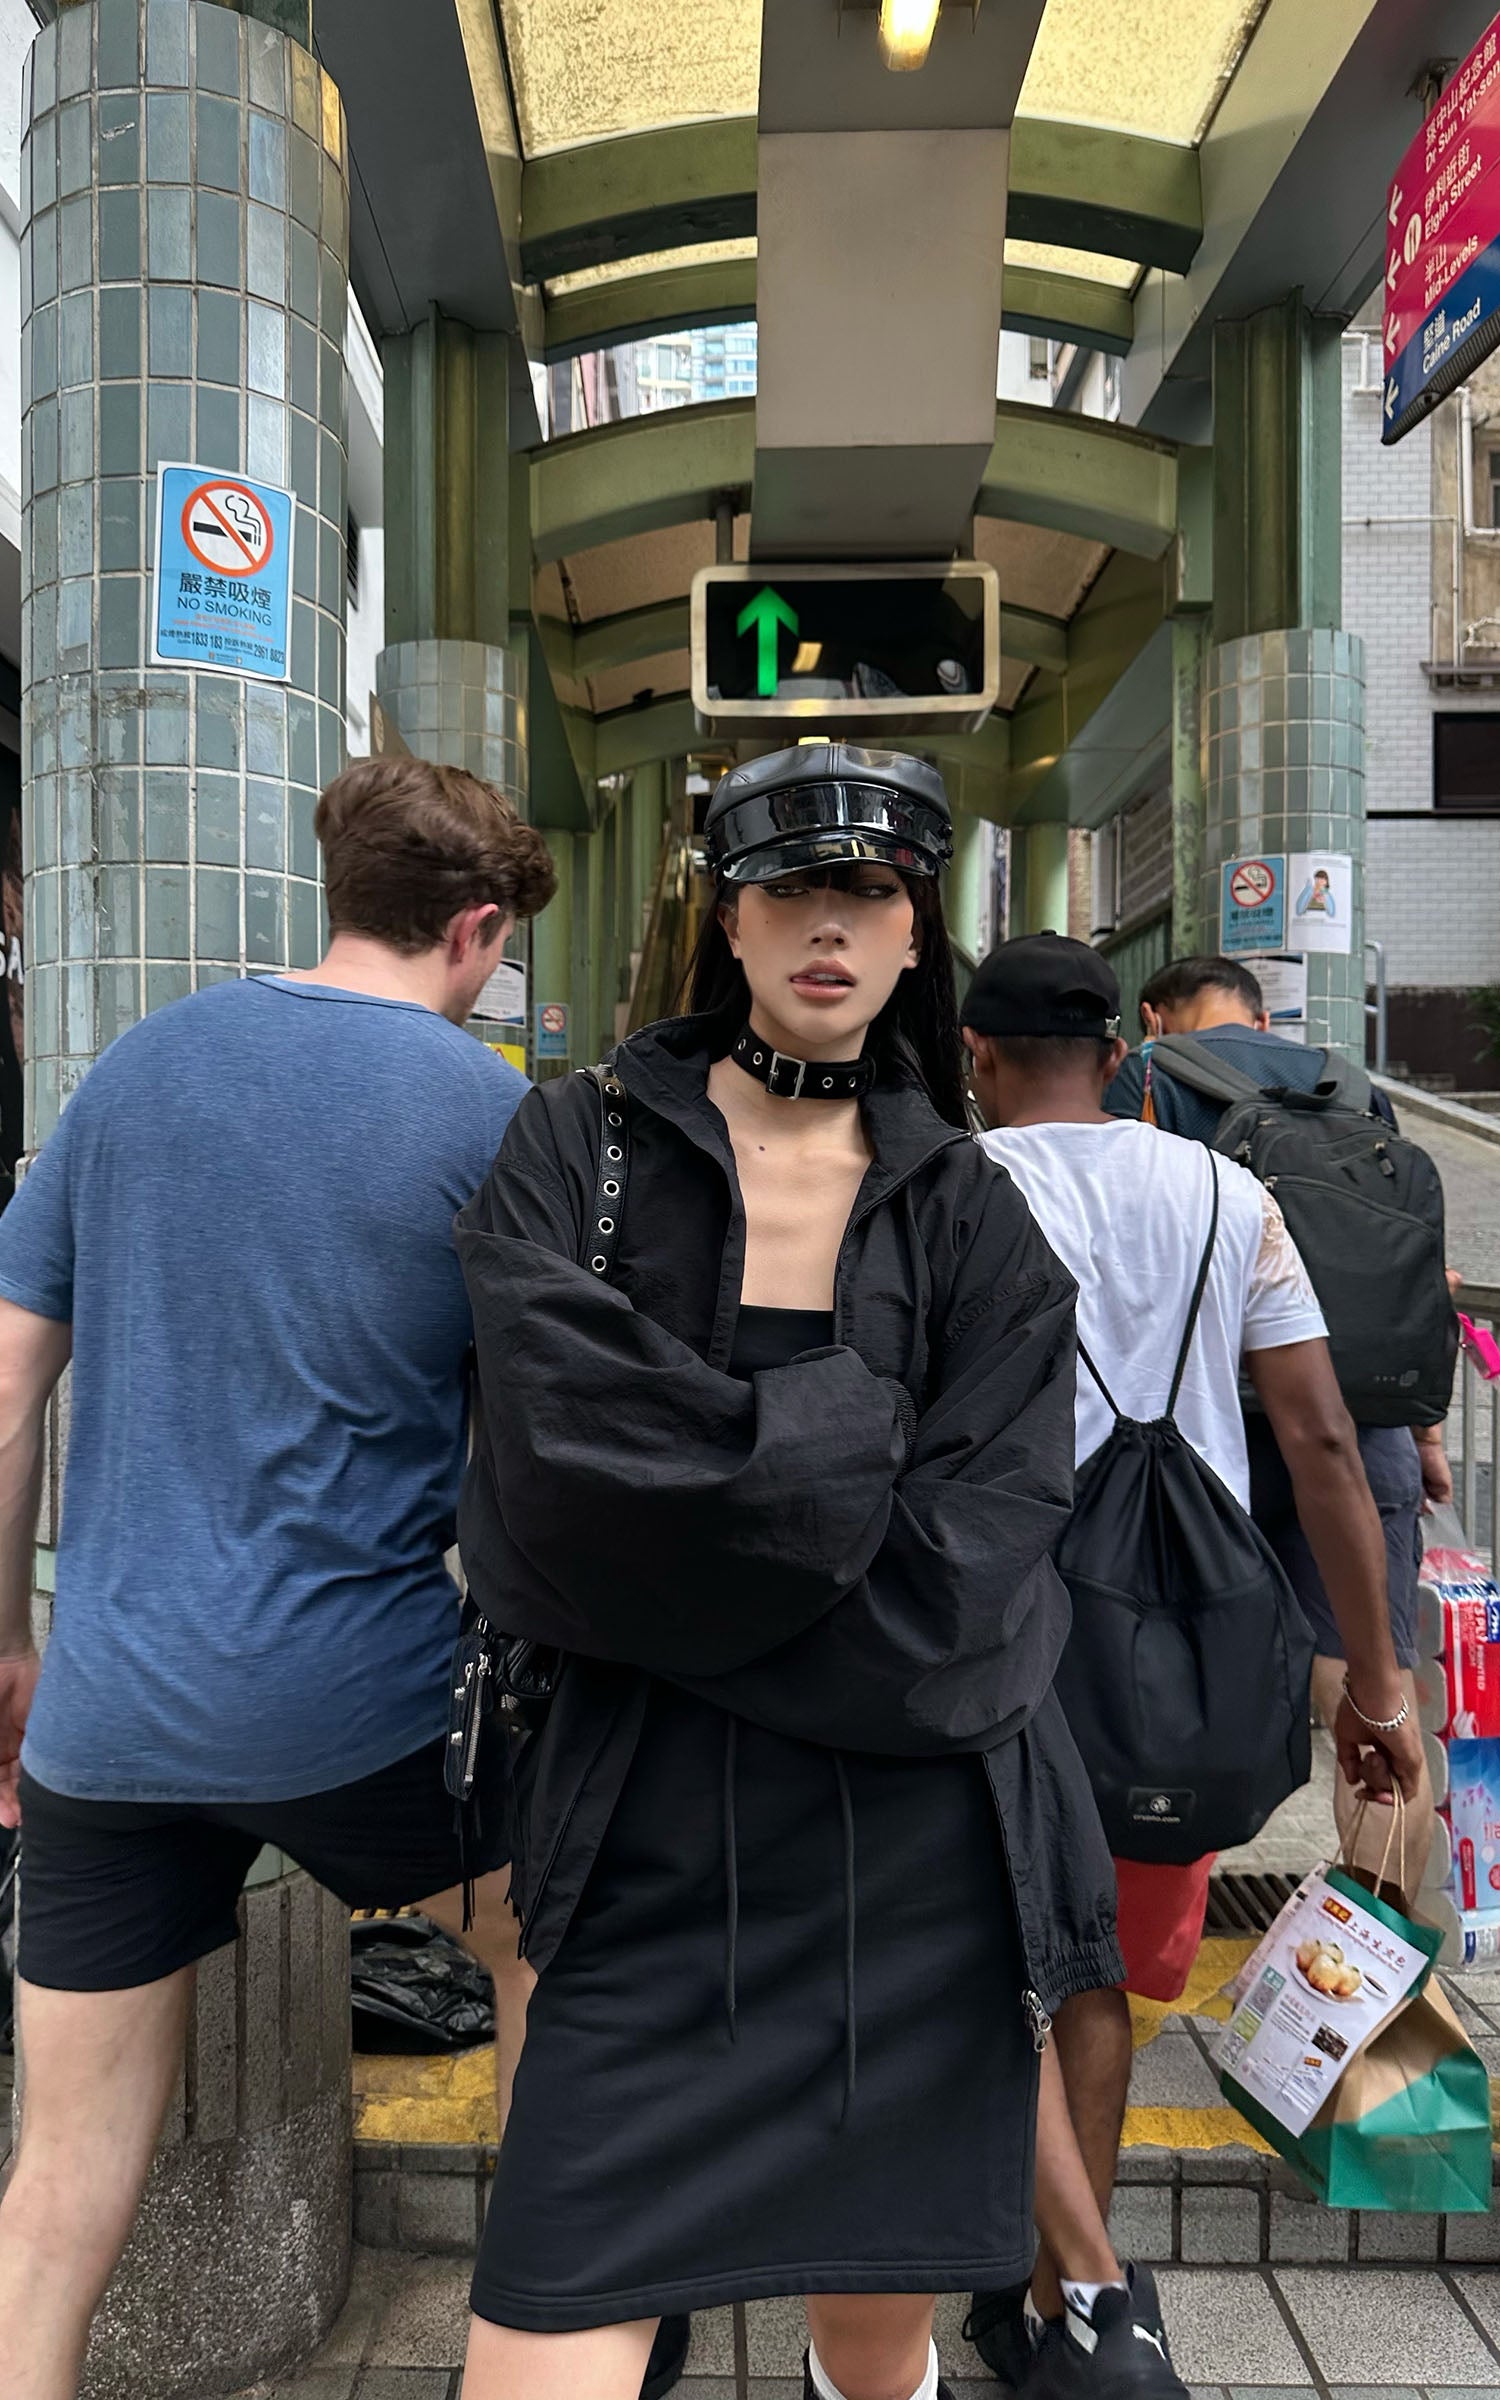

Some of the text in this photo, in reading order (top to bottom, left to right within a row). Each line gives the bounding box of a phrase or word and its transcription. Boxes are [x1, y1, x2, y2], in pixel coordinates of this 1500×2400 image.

[1425, 59, 1500, 173] Dr Sun Yat-sen
[1425, 153, 1481, 241] Elgin Street
[1424, 244, 1447, 284] 半山
[1424, 234, 1479, 309] Mid-Levels
[1422, 297, 1481, 375] Caine Road
[177, 596, 201, 611] NO
[204, 600, 273, 627] SMOKING
[179, 572, 272, 611] 嚴禁吸煙
